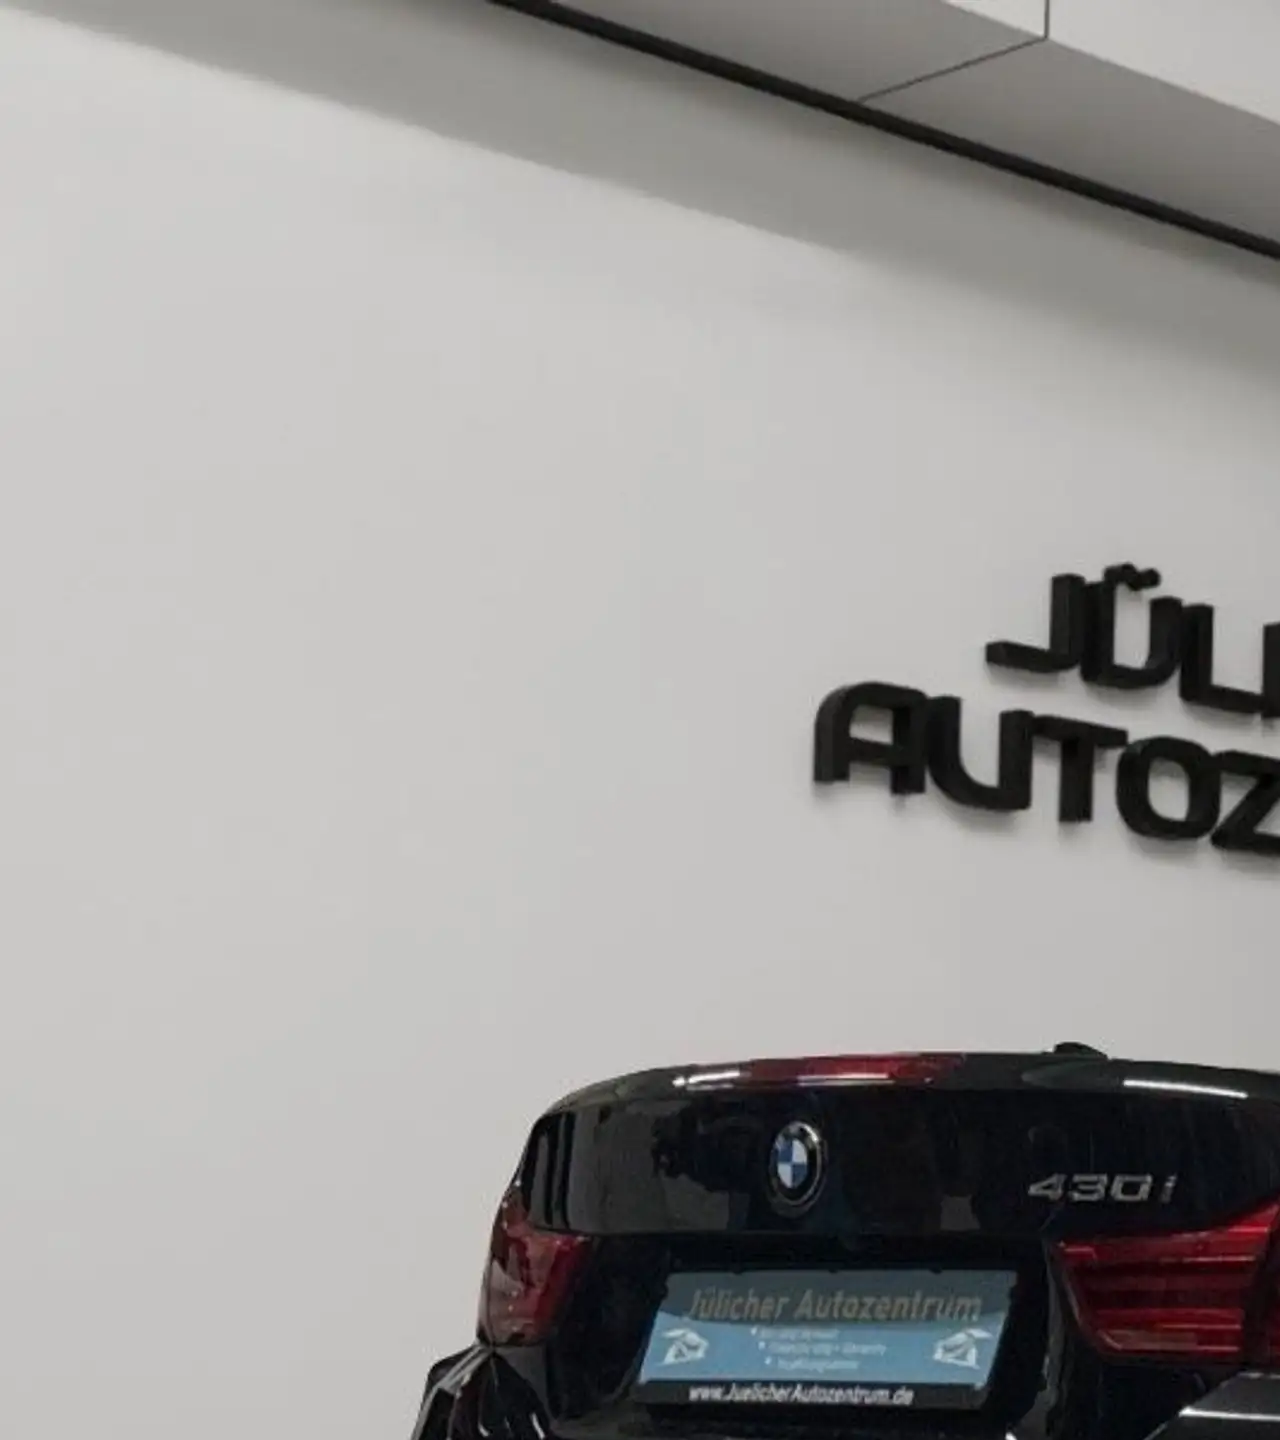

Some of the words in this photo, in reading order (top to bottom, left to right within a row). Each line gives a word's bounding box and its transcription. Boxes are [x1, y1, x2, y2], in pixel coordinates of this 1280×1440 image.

[1028, 1173, 1177, 1203] 430i
[688, 1288, 789, 1320] Jülicher
[794, 1289, 984, 1322] Autozentrum
